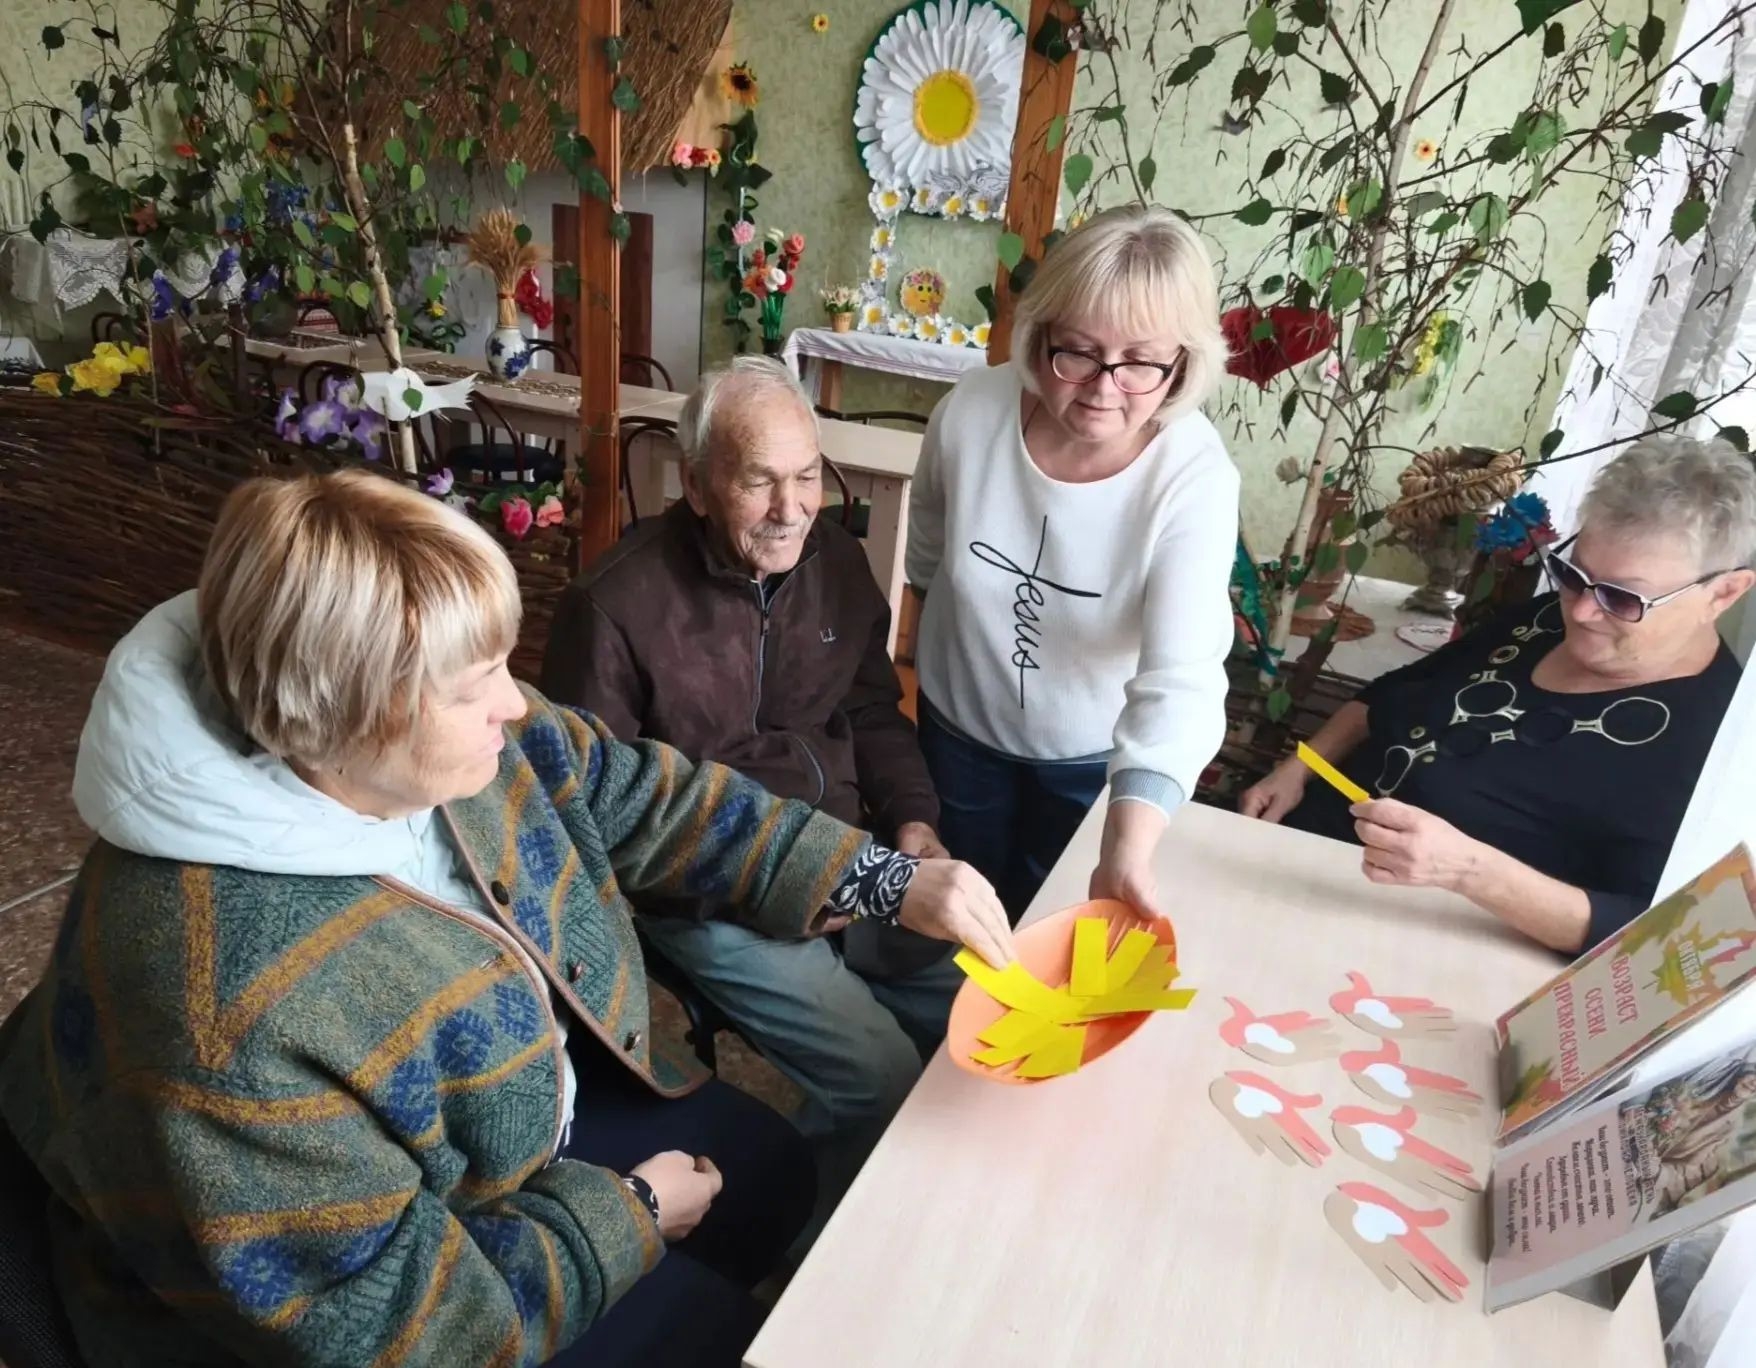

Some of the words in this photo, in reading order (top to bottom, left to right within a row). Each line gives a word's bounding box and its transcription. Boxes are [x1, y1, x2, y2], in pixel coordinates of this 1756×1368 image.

[969, 514, 1102, 709] Jesus
[1585, 987, 1607, 1040] ОСЕНИ
[1611, 955, 1638, 1024] ВОЗРАСТ
[1554, 982, 1584, 1089] ПРЕКРАСНЫЙ
